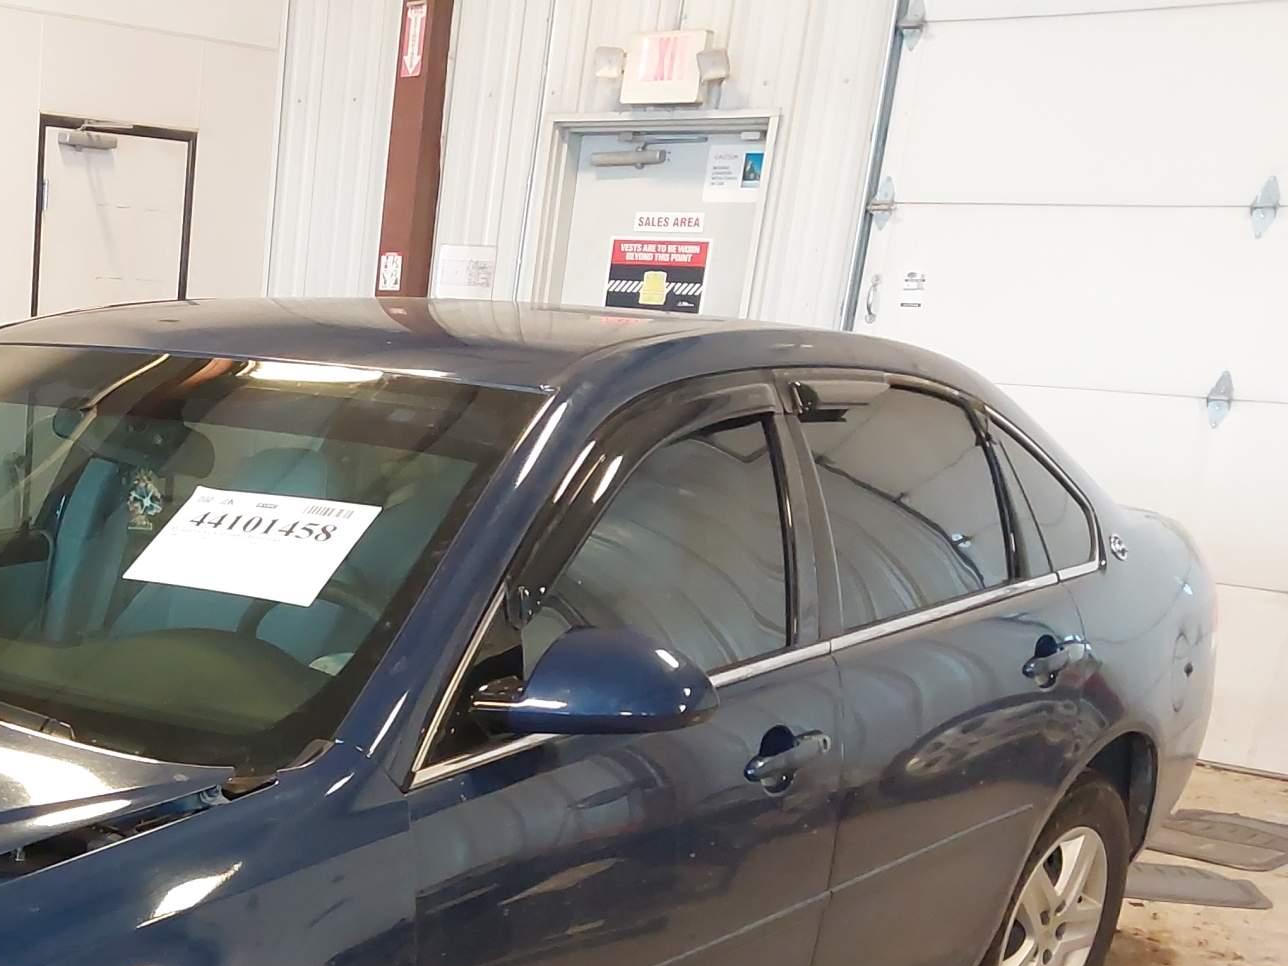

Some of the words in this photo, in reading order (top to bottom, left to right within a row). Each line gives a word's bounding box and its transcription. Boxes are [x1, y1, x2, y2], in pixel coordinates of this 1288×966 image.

[638, 216, 670, 228] SALES
[672, 217, 700, 228] AREA
[620, 243, 643, 252] VESTS
[642, 243, 657, 253] ARE
[657, 244, 667, 253] TO
[189, 511, 338, 542] 44101458
